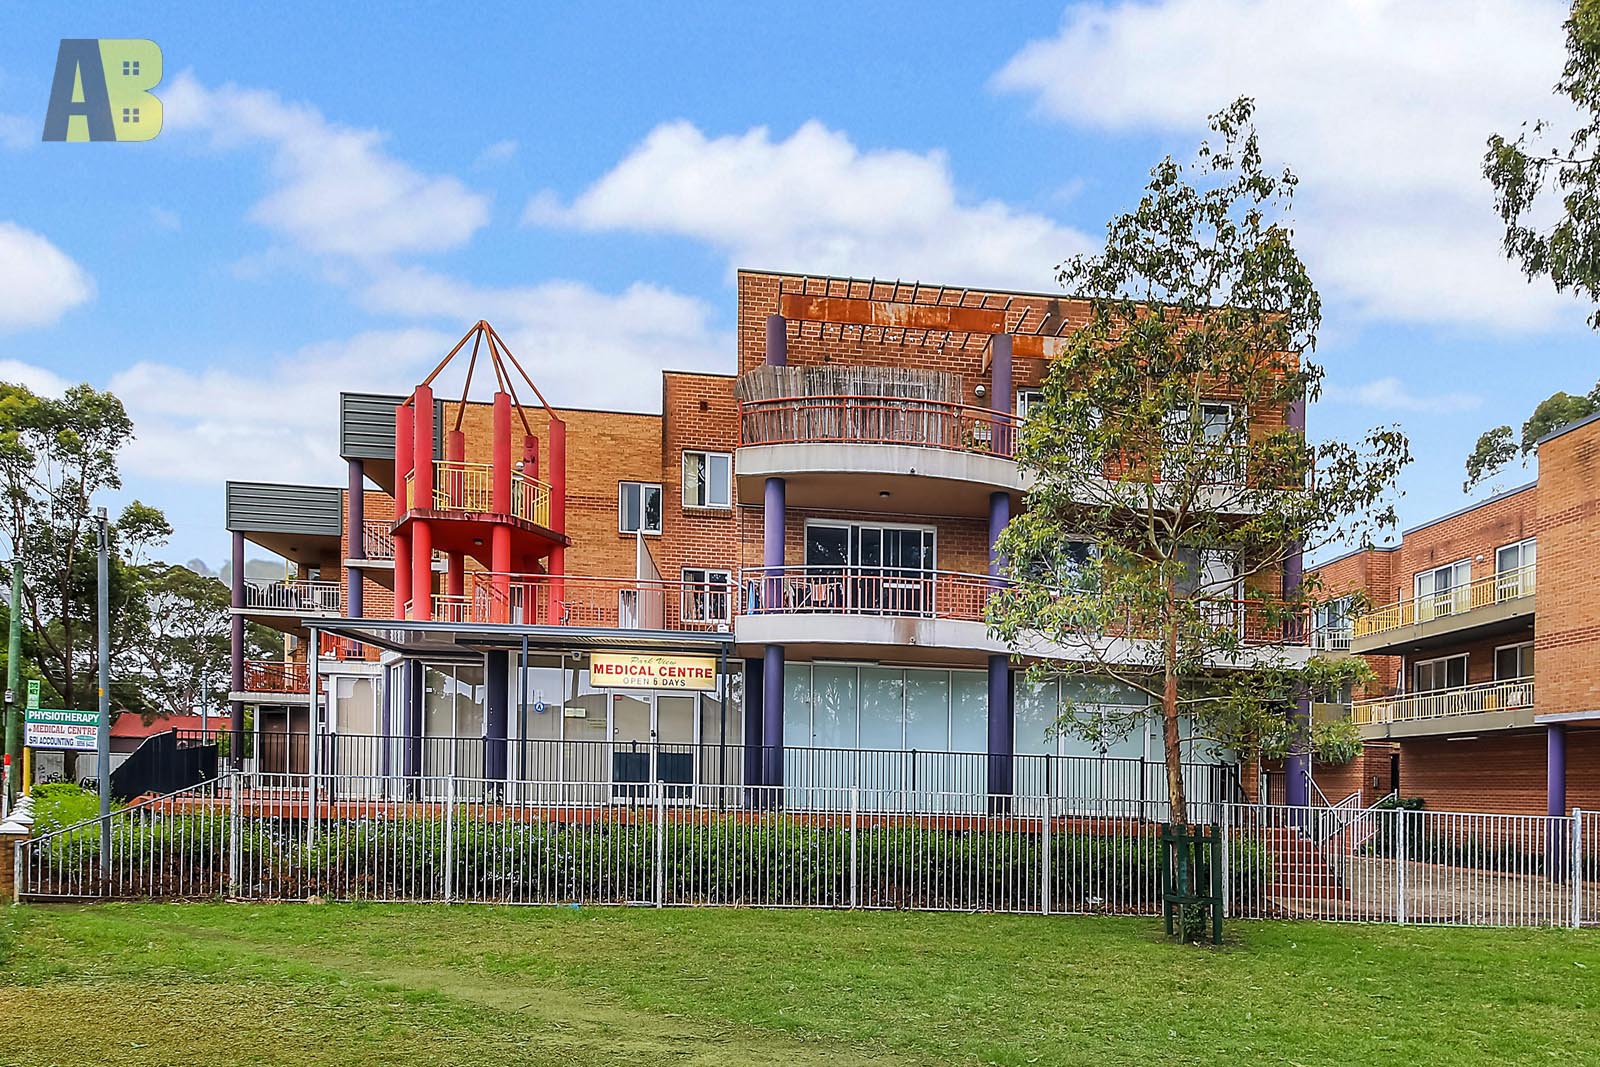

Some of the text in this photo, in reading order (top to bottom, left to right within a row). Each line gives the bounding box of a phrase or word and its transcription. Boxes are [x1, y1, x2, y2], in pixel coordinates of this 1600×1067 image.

[630, 656, 677, 665] Park View
[593, 664, 713, 678] MEDICAL CENTRE
[623, 677, 649, 685] OPEN
[662, 678, 686, 686] DAYS
[28, 711, 100, 722] PHYSIOTHERAPY
[33, 725, 96, 735] MEDICAL CENTRE
[39, 736, 74, 746] ACCOUNTING
